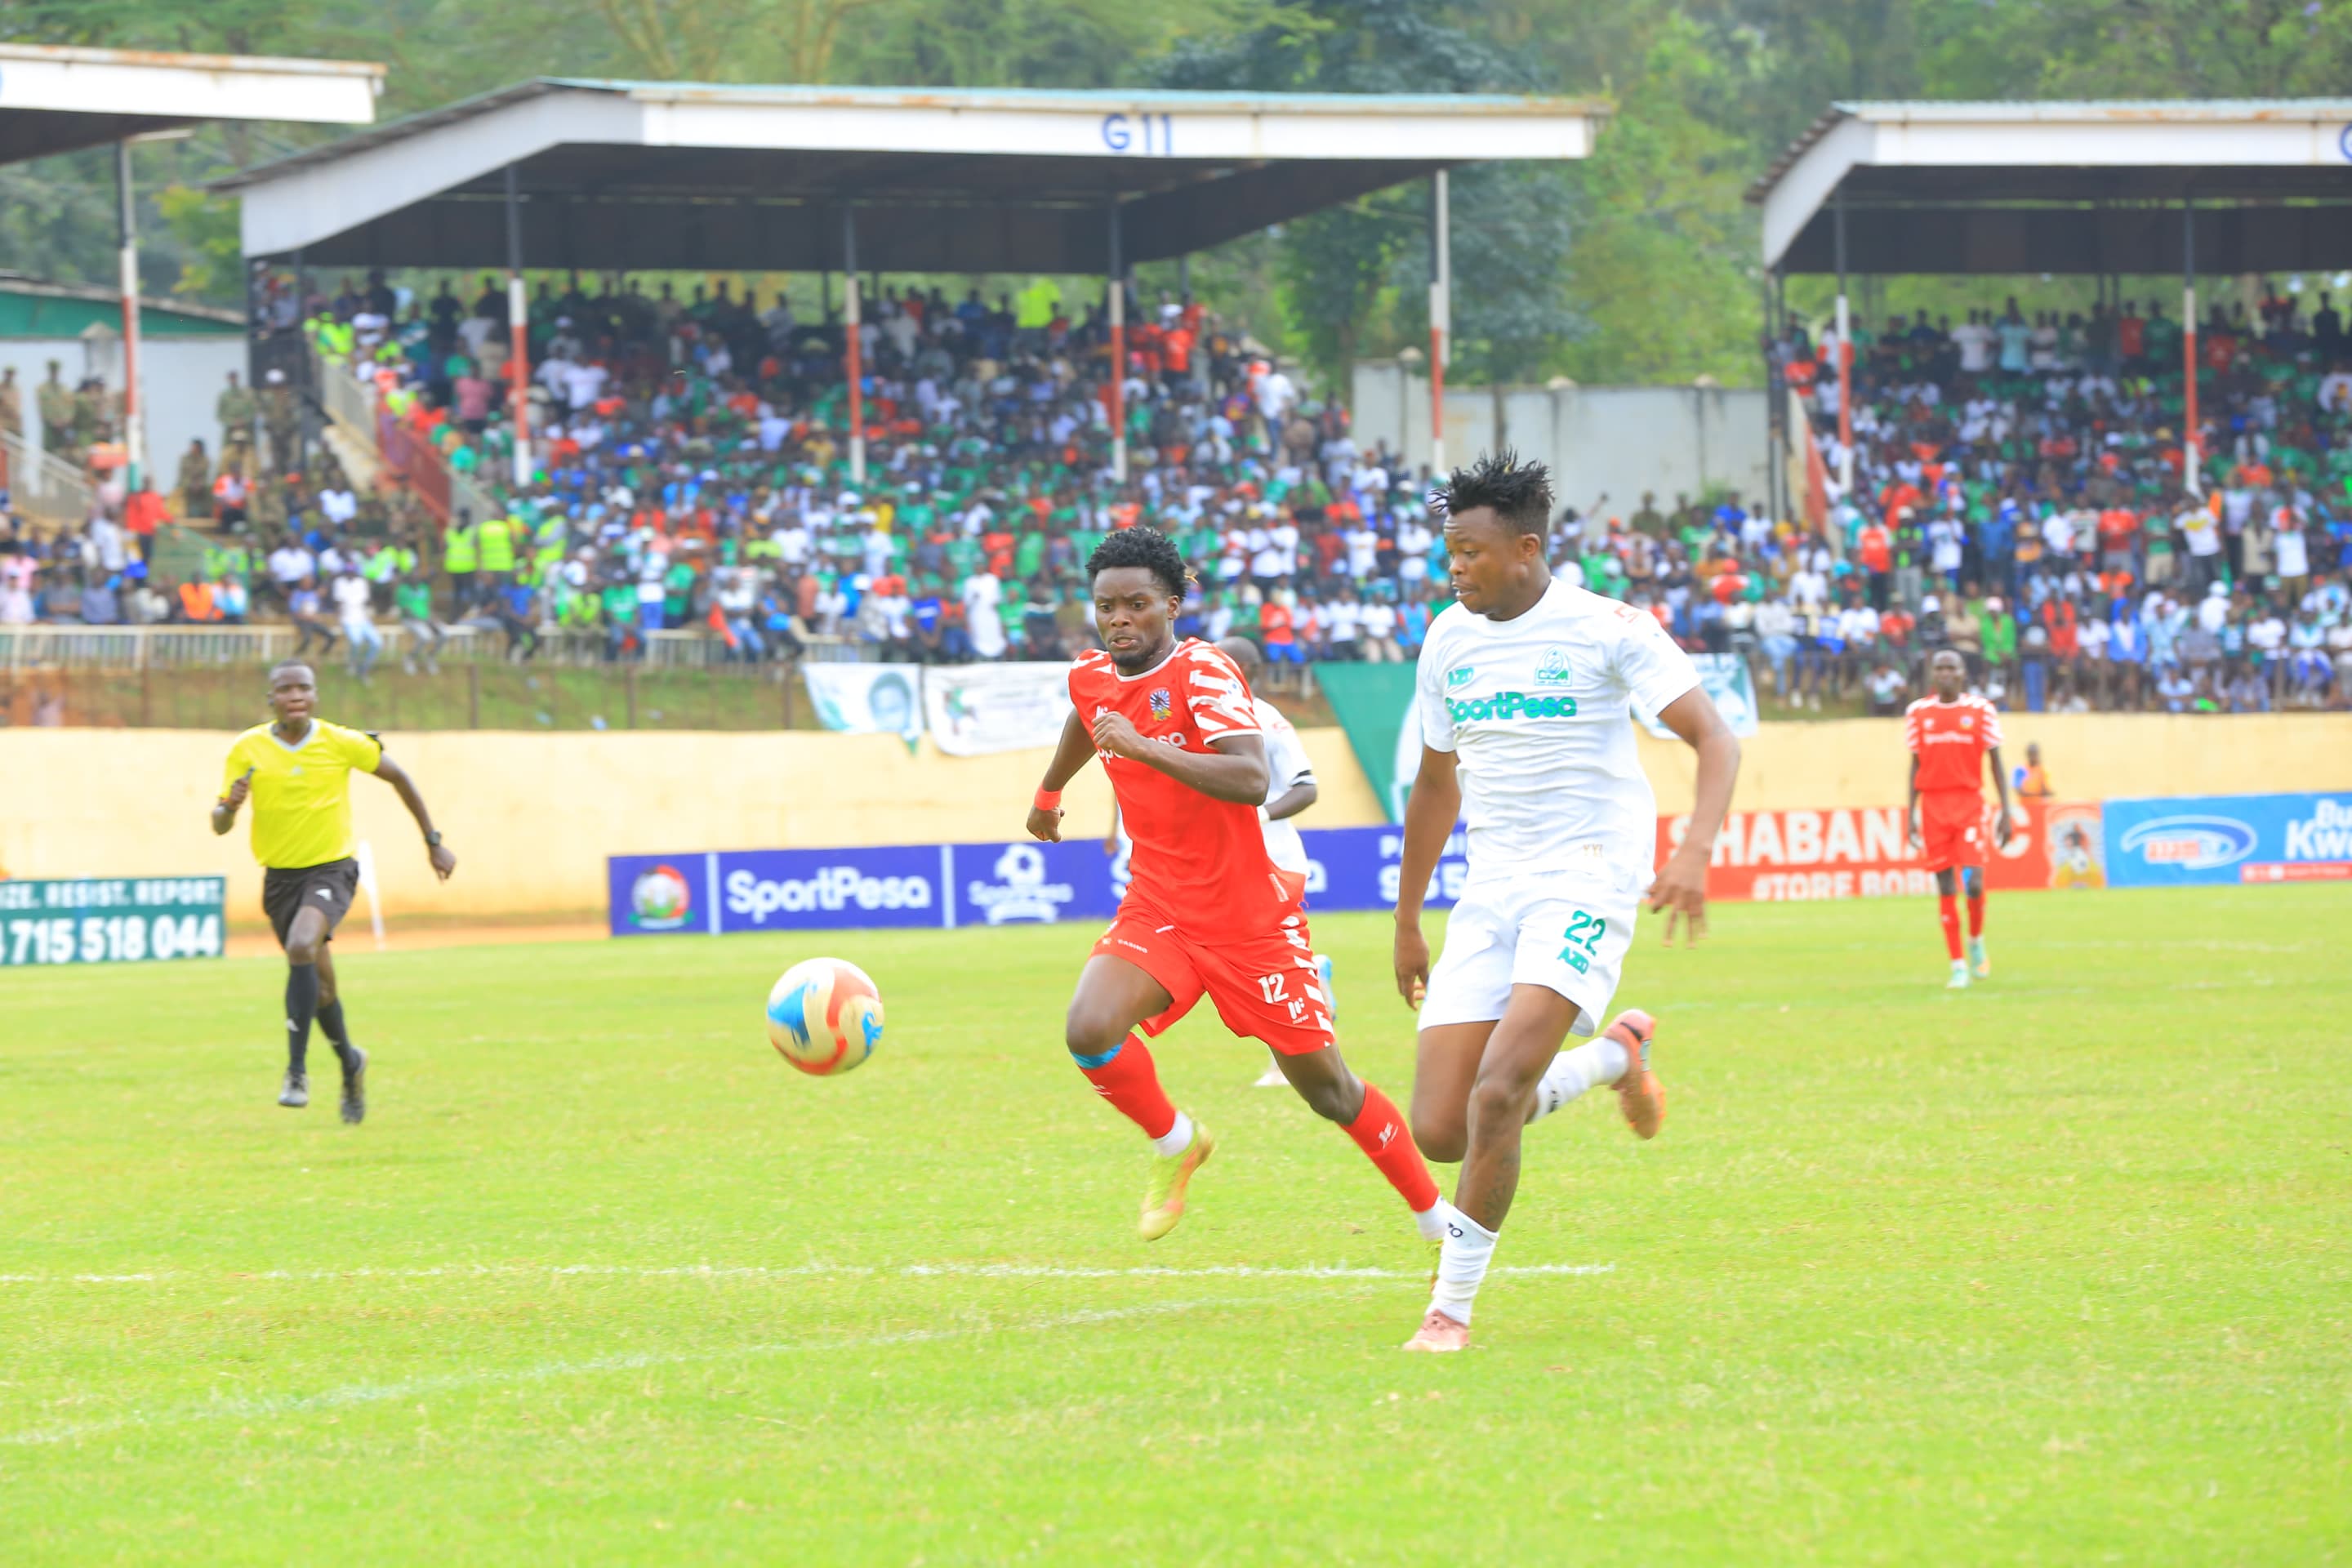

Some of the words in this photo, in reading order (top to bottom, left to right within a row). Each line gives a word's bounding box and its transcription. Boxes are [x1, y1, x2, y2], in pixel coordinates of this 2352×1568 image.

[1102, 113, 1173, 156] G11
[726, 866, 931, 924] SportPesa
[9, 919, 76, 964] 715
[82, 916, 146, 960] 518
[152, 915, 220, 959] 044
[1563, 910, 1606, 956] 22
[1258, 973, 1289, 1004] 12
